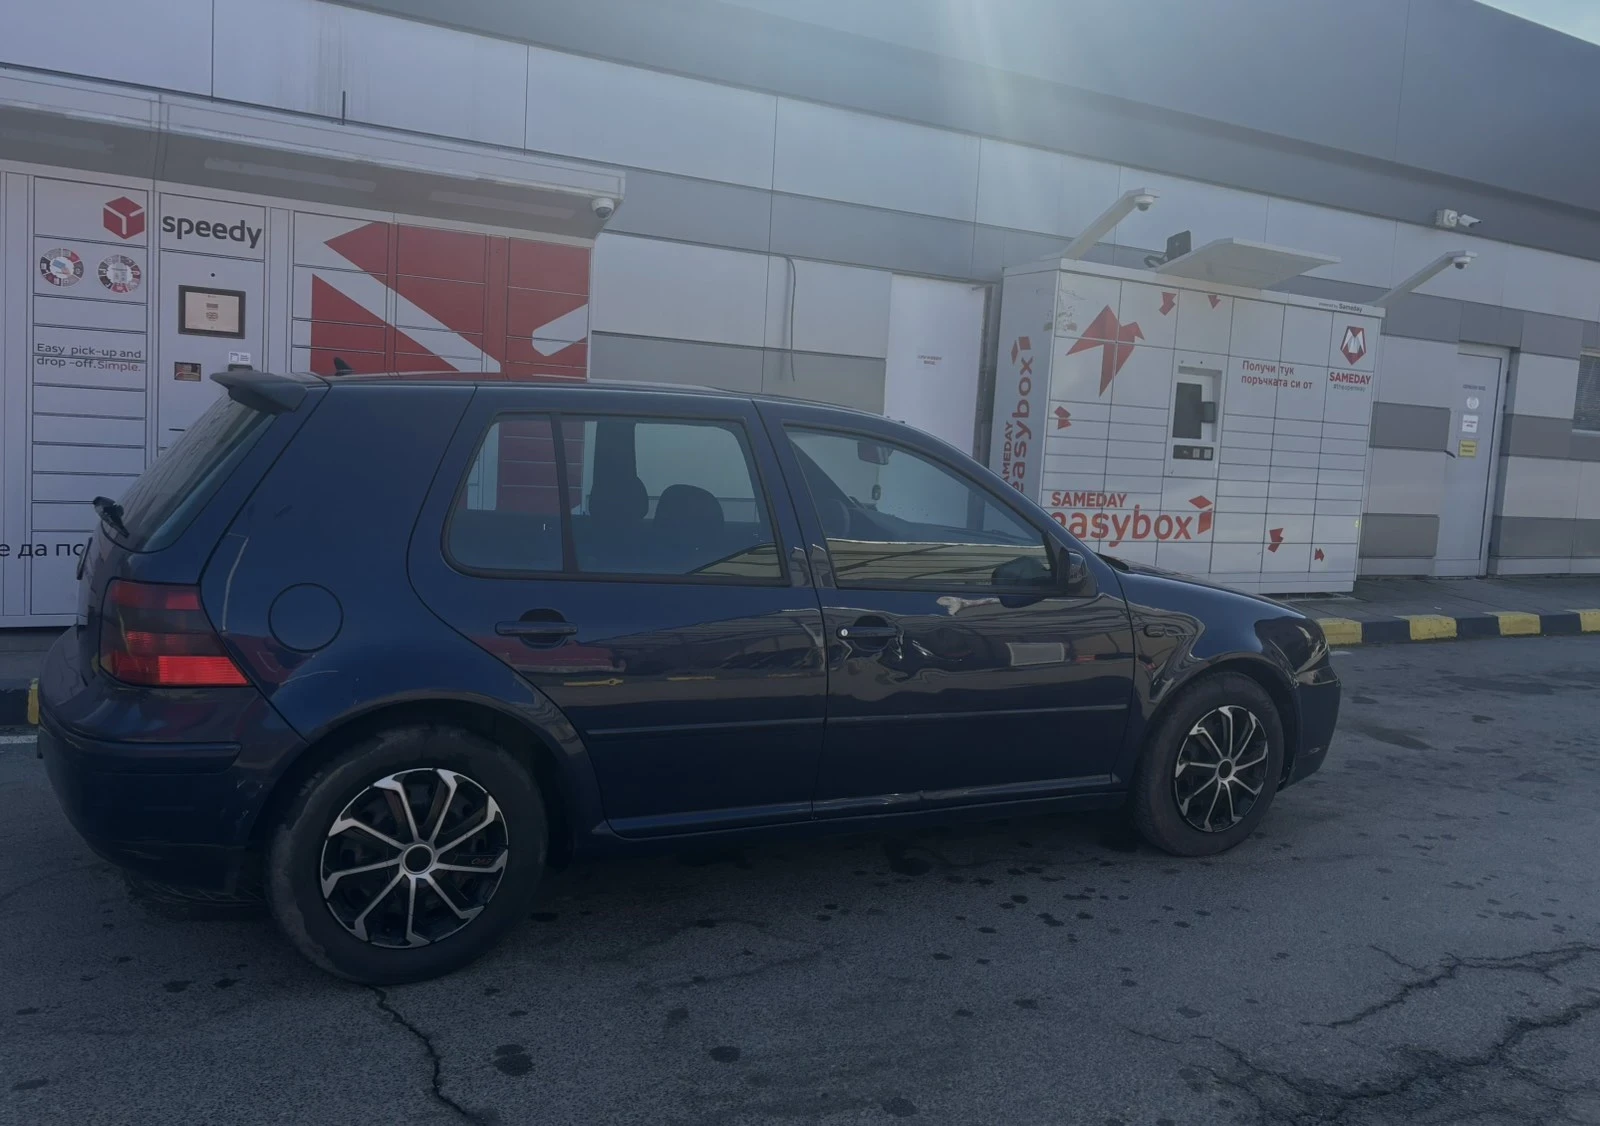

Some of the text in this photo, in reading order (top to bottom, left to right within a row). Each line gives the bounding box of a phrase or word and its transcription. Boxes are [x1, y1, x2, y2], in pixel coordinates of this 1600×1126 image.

[162, 215, 263, 249] speedy
[1339, 303, 1363, 313] Sameday
[37, 343, 142, 359] Easy pick-up and
[36, 356, 66, 368] drop
[1242, 360, 1295, 376] Получи тук
[1241, 375, 1313, 389] поръчката си от
[1329, 371, 1371, 385] SAMEDAY
[1002, 420, 1013, 482] AMEDAY
[1051, 491, 1127, 507] SAMEDAY
[17, 543, 48, 559] да
